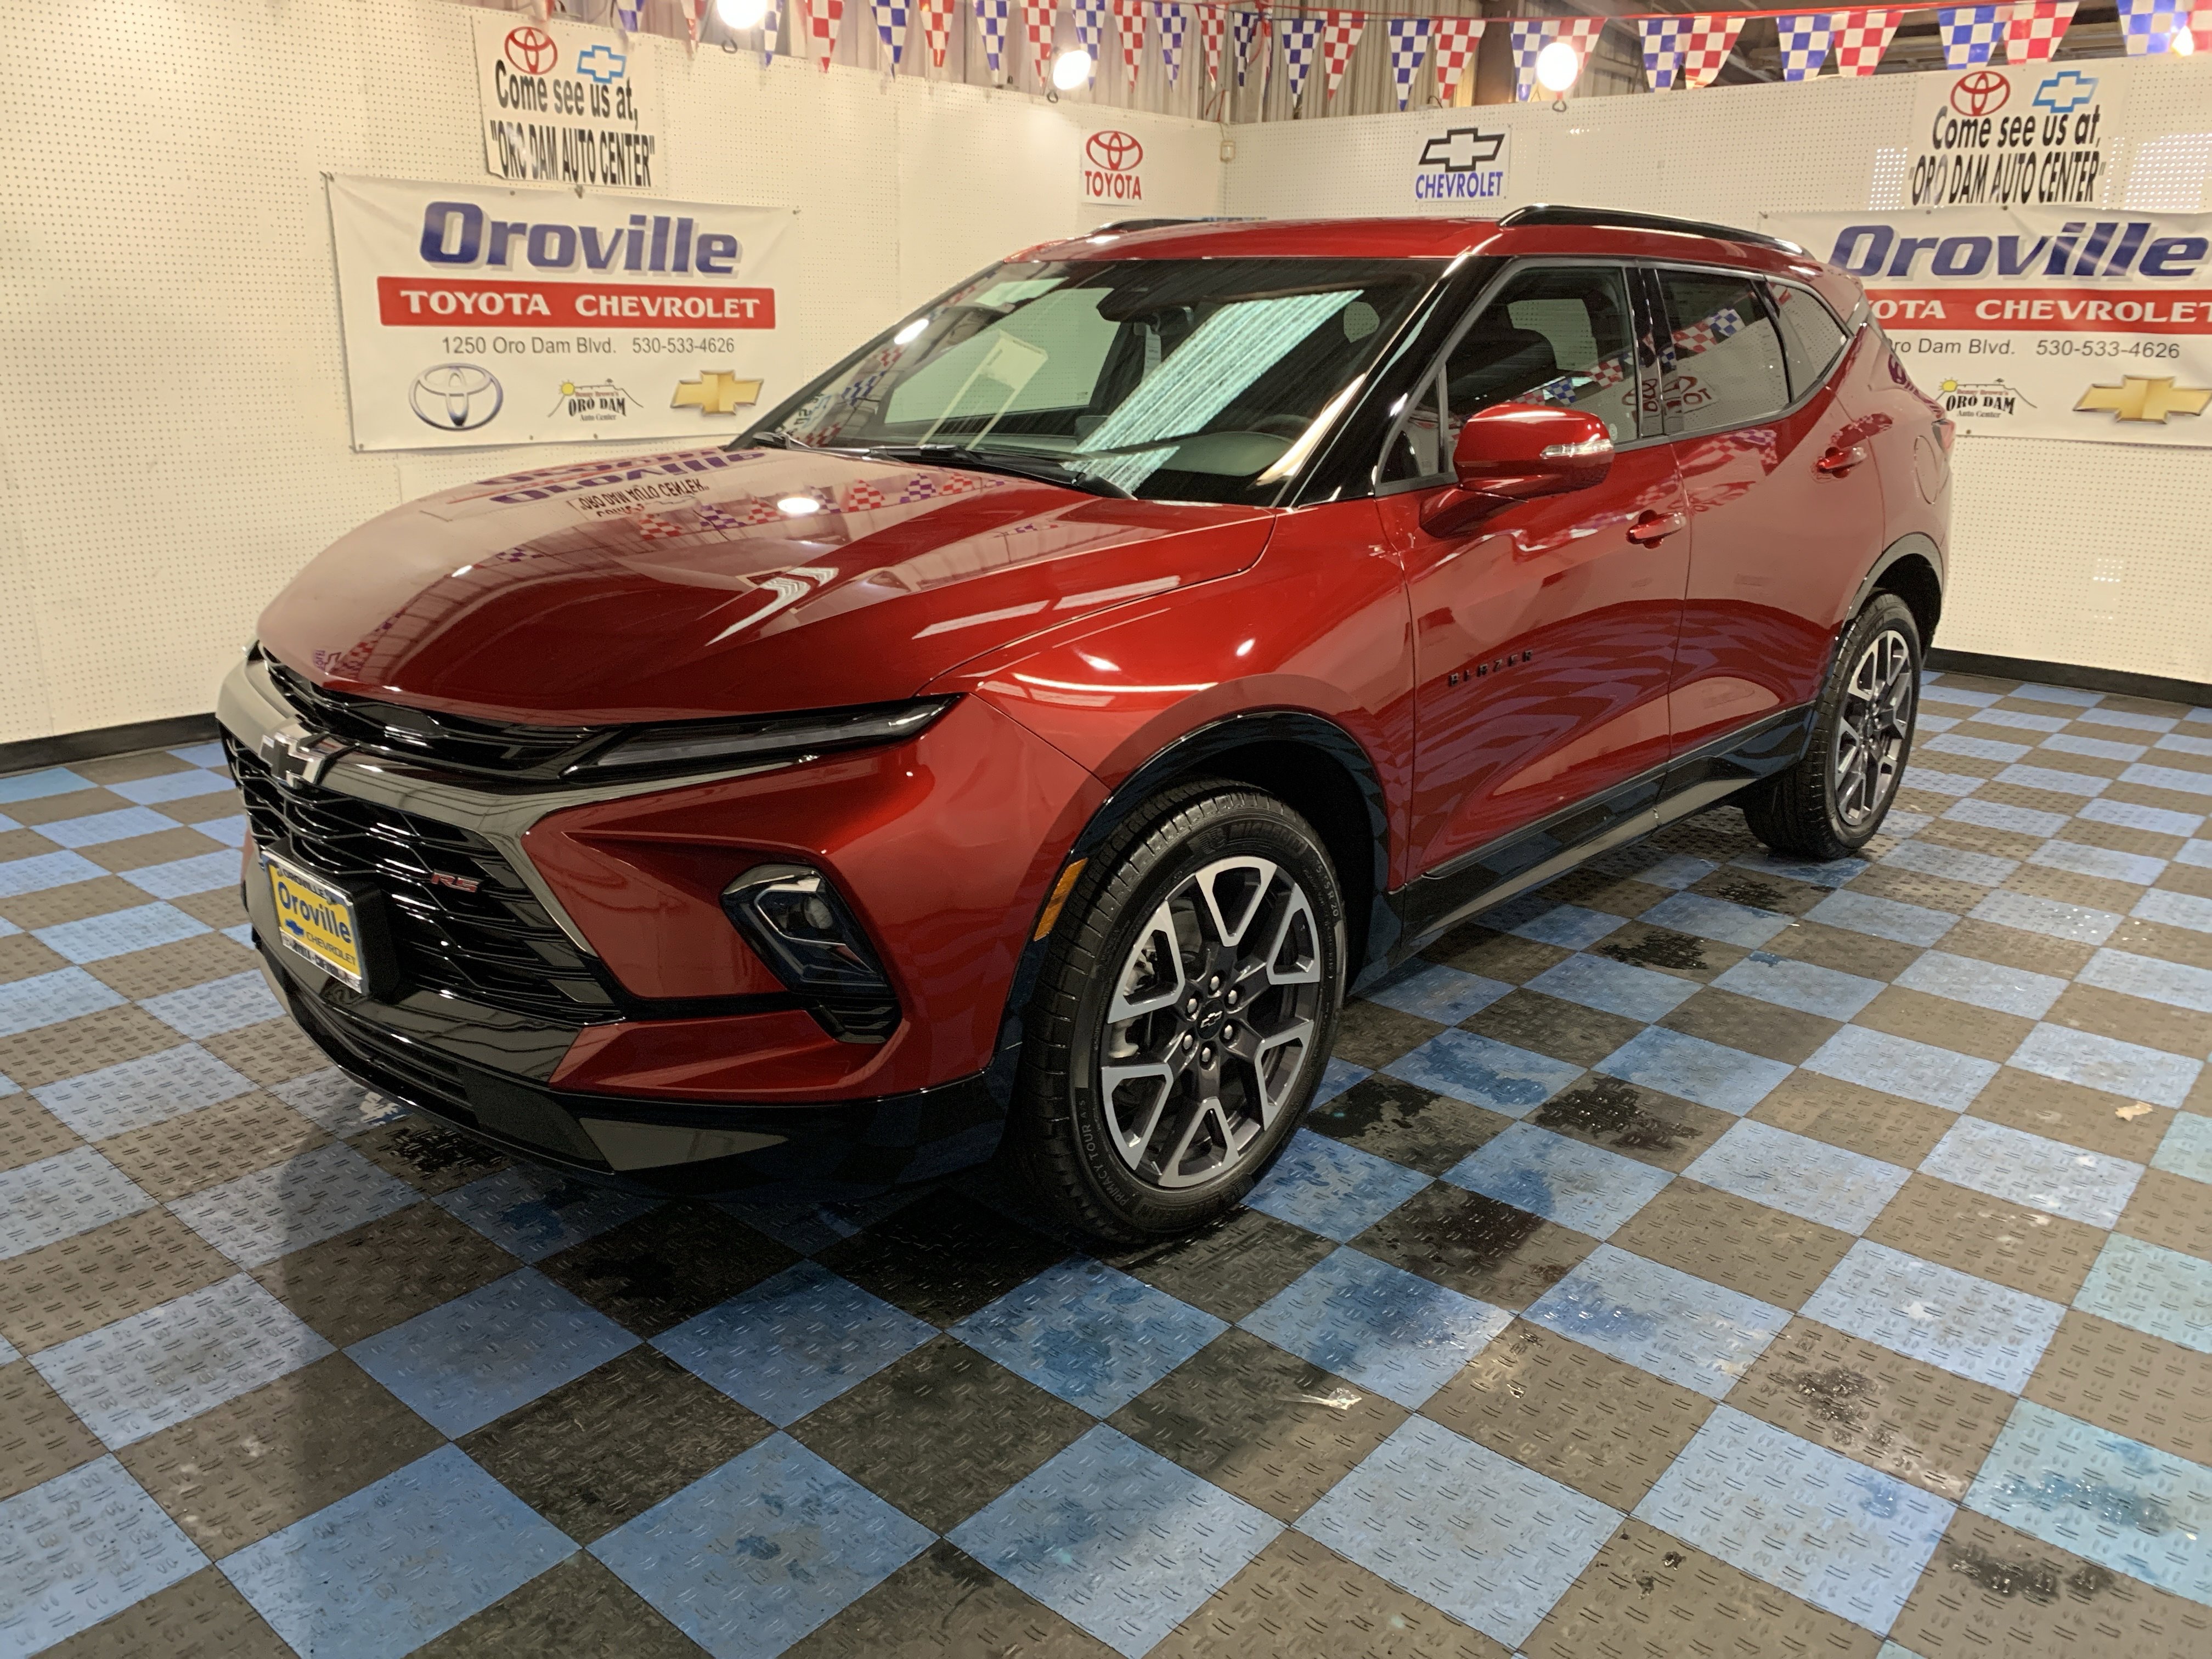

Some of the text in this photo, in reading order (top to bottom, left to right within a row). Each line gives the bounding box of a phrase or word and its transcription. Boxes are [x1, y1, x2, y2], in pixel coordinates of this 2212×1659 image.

[495, 59, 638, 131] Come see us at,
[1932, 104, 2101, 150] Come see us at,
[528, 123, 558, 180] DAM
[562, 127, 596, 184] AUTO
[600, 129, 656, 187] CENTER"
[1085, 170, 1142, 200] TOYOTA
[1415, 171, 1504, 199] CHEVROLET
[1949, 154, 1990, 204] DAM
[1989, 151, 2036, 204] AUTO
[2039, 151, 2107, 203] CENTER"
[420, 201, 740, 275] Oroville
[1829, 222, 2209, 276] Oroville
[400, 290, 760, 318] TOYOTA CHEVROLET
[1869, 299, 1946, 319] OTA
[442, 336, 735, 354] 1250 Oro Dam Blvd. 530-533-4626
[1888, 338, 2181, 359] ro Dam Blvd. 530-533-4626
[568, 397, 627, 416] ORO DAM
[1946, 395, 2016, 415] ORO DAM
[1448, 650, 1533, 686] BLAZER
[431, 871, 479, 893] RS
[278, 881, 352, 944] Oroville
[306, 932, 356, 966] CHEVROLET
[1081, 1124, 1099, 1161] TOUR
[1094, 1164, 1130, 1206] PRIMACY
